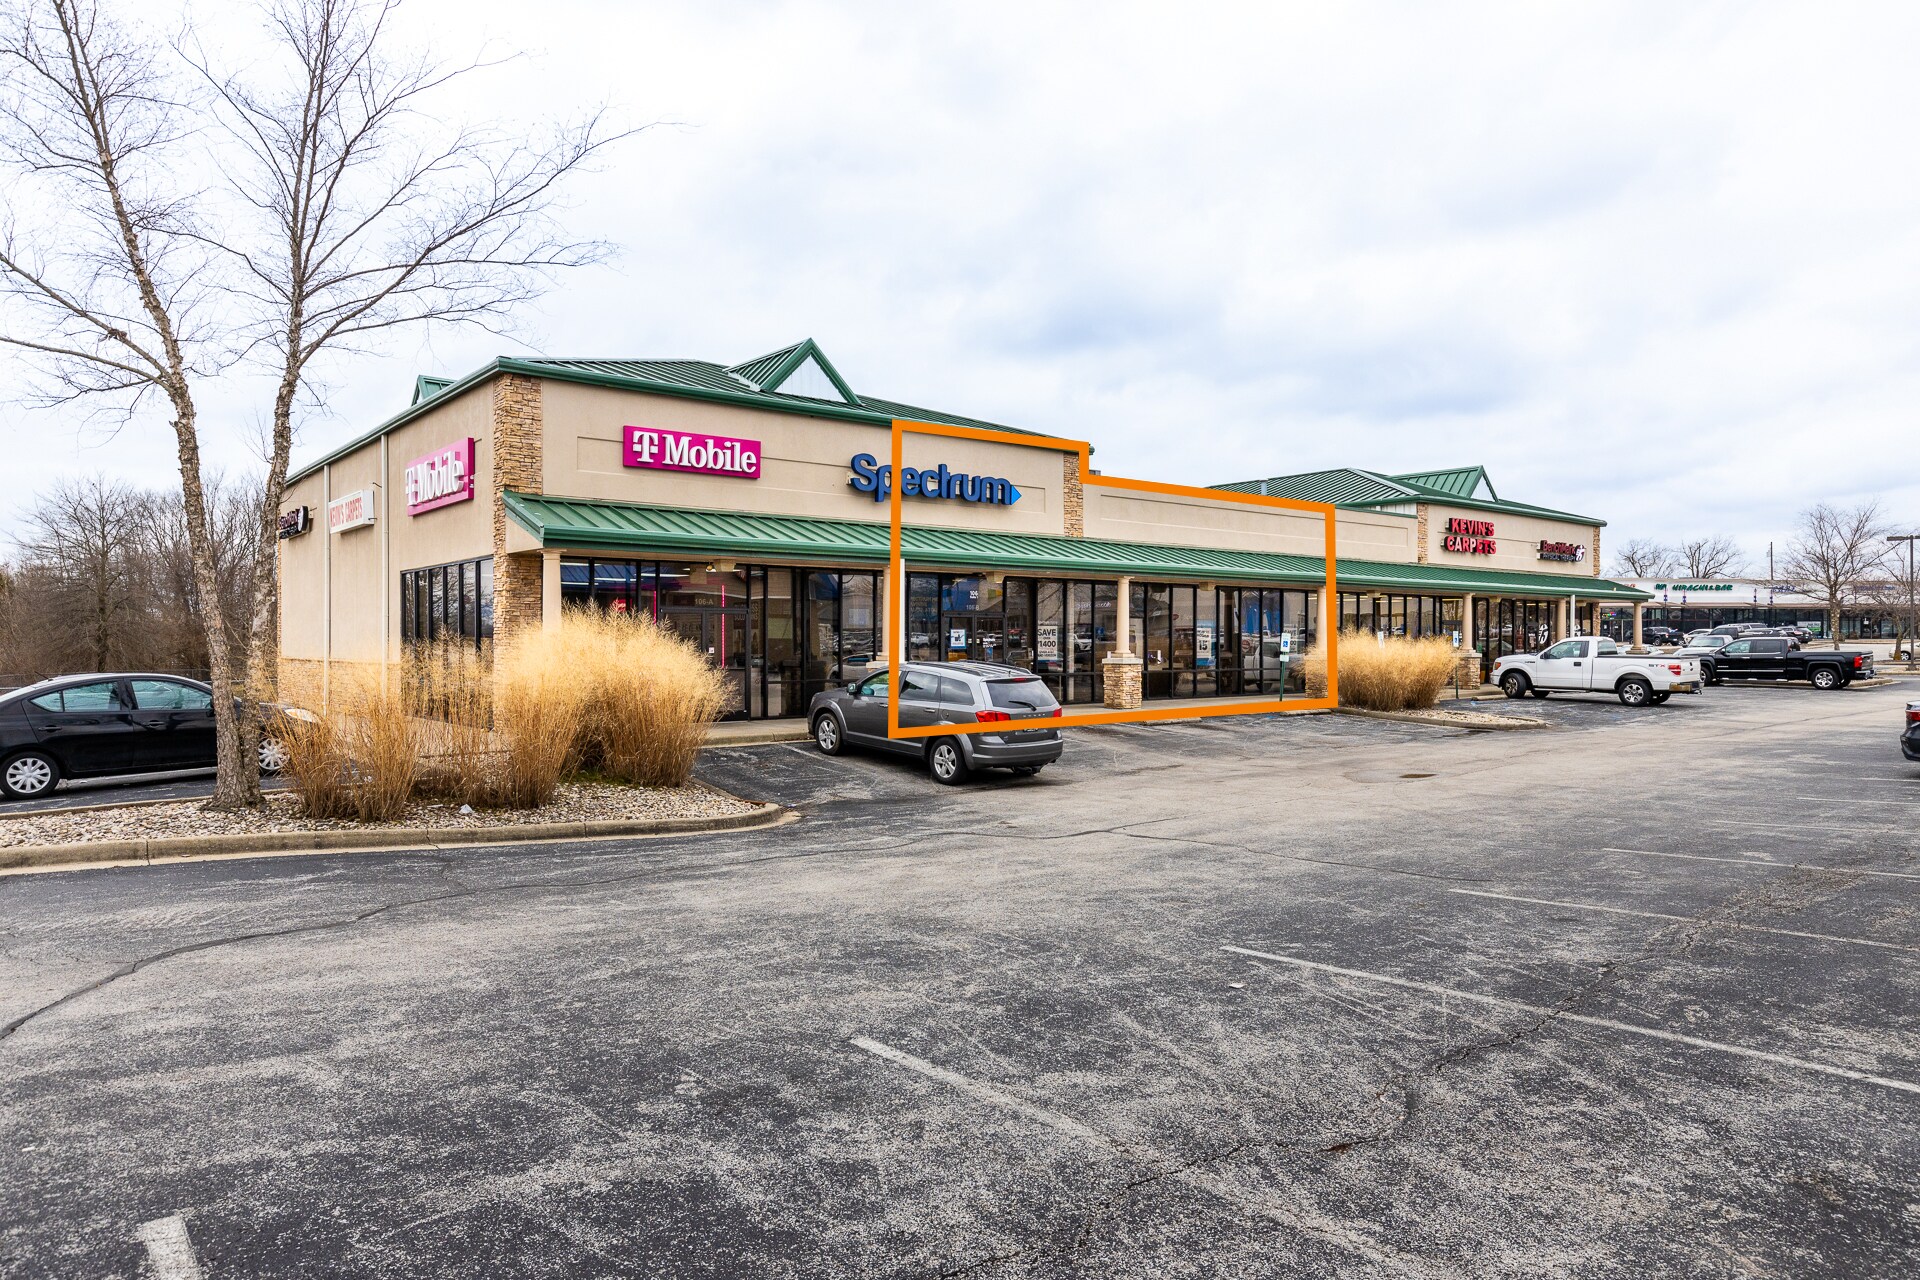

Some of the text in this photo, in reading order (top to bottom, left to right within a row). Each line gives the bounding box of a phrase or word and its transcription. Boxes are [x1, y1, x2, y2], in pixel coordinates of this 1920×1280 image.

[850, 453, 1013, 506] Spectrum
[1450, 518, 1495, 536] KEVIN'S
[1446, 536, 1496, 555] CARPETS
[1037, 628, 1057, 637] SAVE
